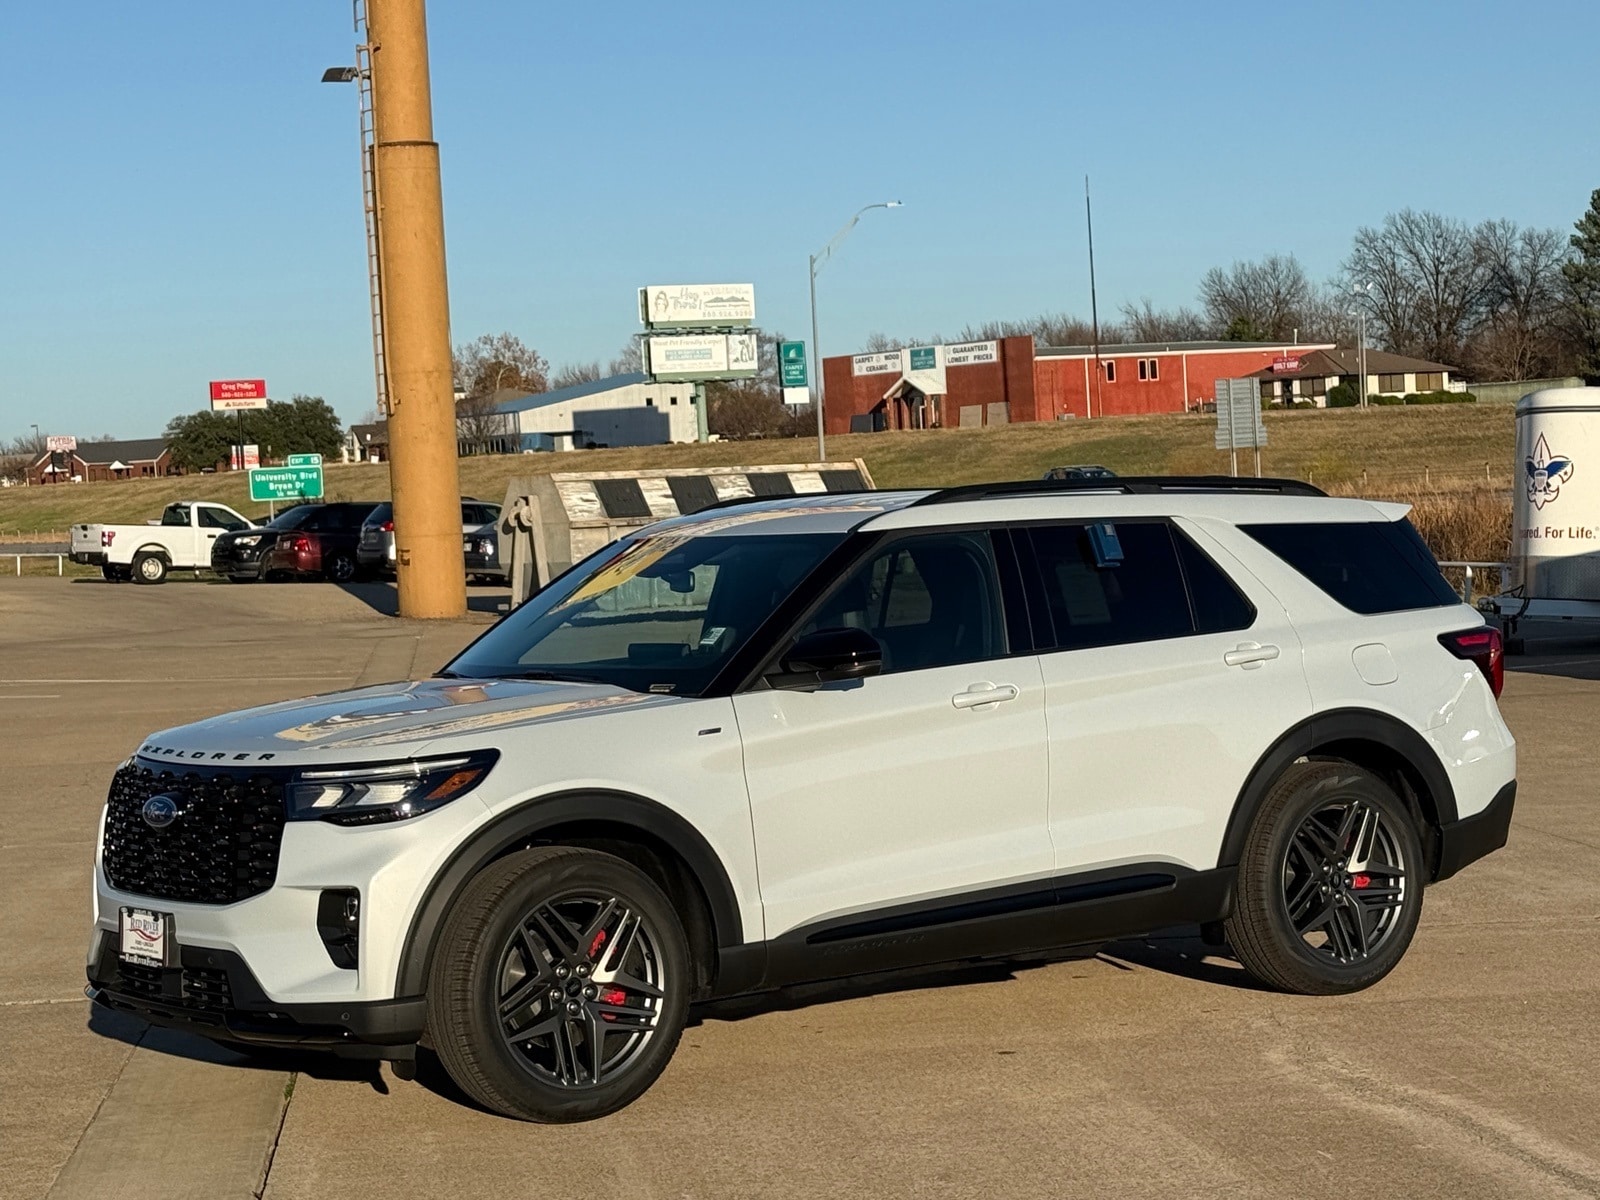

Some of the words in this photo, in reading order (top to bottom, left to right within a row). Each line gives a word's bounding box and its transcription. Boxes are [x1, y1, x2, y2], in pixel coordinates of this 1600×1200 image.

[952, 344, 988, 354] GUARANTEED
[855, 356, 874, 364] CARPET
[884, 353, 900, 361] WOOD
[947, 355, 969, 363] LOWEST
[973, 353, 993, 361] PRICES
[865, 364, 888, 372] CERAMIC
[221, 383, 236, 391] Greg
[310, 456, 319, 464] 15
[255, 472, 297, 482] University
[299, 471, 318, 479] Blvd
[269, 482, 293, 491] Bryan
[295, 481, 305, 489] Dr
[1545, 526, 1565, 539] For
[142, 745, 276, 761] EXPLORER
[130, 917, 142, 929] RED
[142, 918, 160, 932] RIVER
